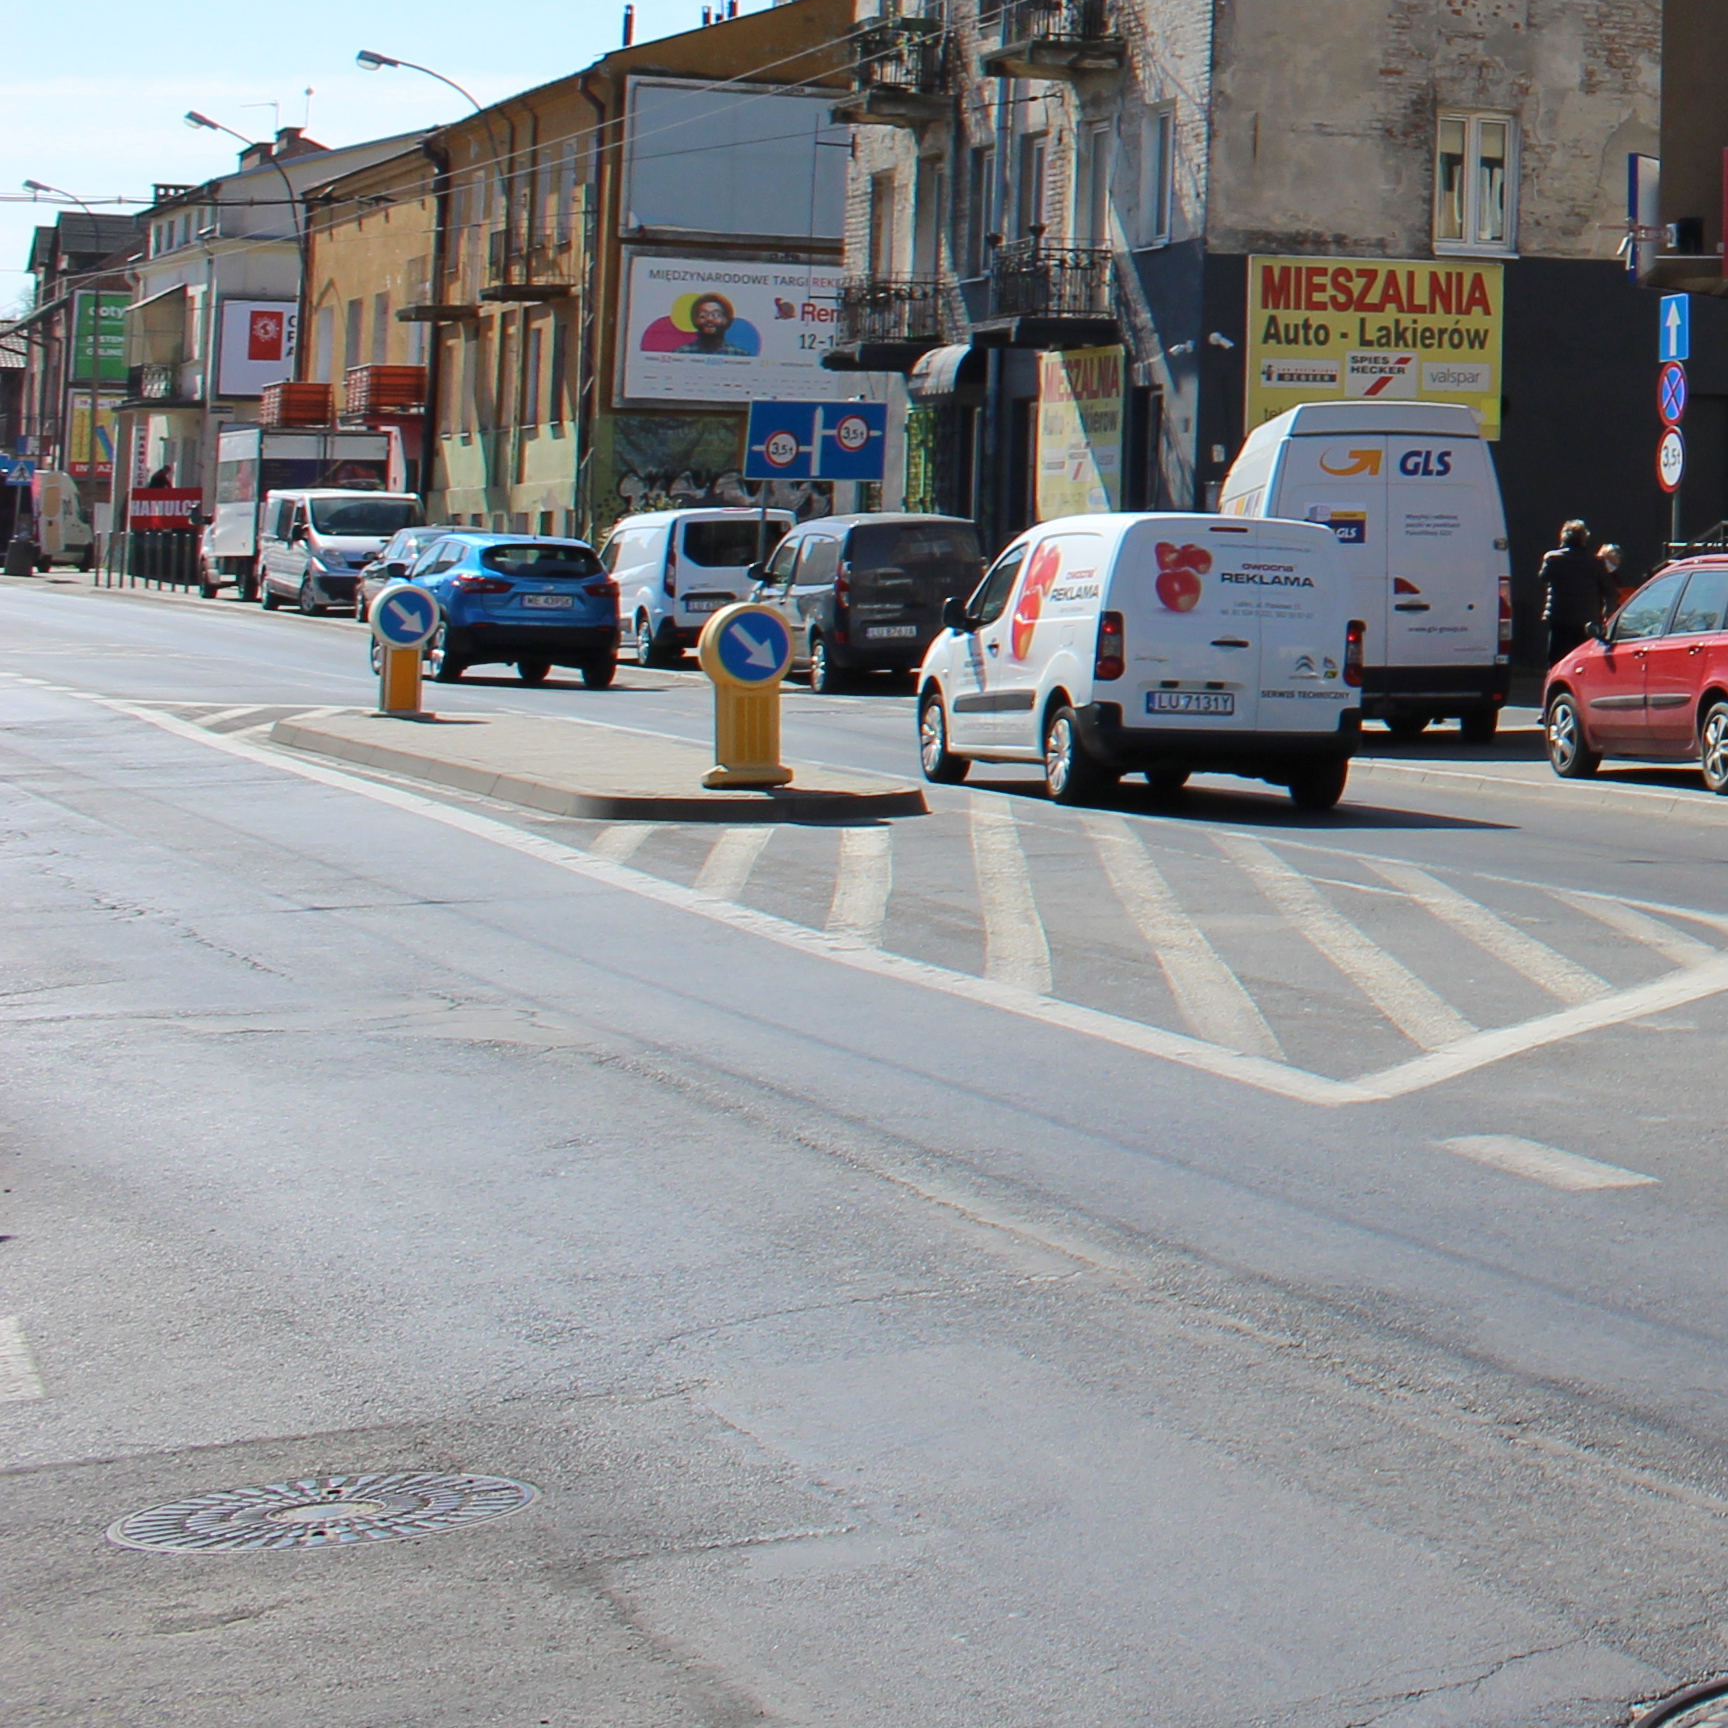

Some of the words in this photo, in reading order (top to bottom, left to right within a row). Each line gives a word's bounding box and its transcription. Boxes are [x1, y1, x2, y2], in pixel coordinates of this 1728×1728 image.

[650, 269, 769, 286] MIĘDZYNARODOWE
[773, 276, 809, 286] TARGI
[1261, 264, 1492, 316] MIESZALNIA
[1262, 315, 1330, 346] Auto
[1359, 317, 1489, 350] Lakierów
[1351, 355, 1390, 365] SPIES
[1350, 365, 1405, 375] HECKER
[1430, 368, 1481, 386] valspar
[841, 426, 865, 441] 3,5t
[1400, 450, 1452, 476] GLS
[1662, 445, 1681, 468] 3,5t
[1336, 527, 1357, 539] GLS
[1220, 572, 1314, 588] REKLAMA
[1050, 584, 1099, 602] REKLAMA
[1158, 695, 1180, 709] LU
[1185, 694, 1231, 709] 7131Y
[1261, 690, 1295, 699] SERWIS
[1298, 690, 1351, 699] TECHNICZNY
